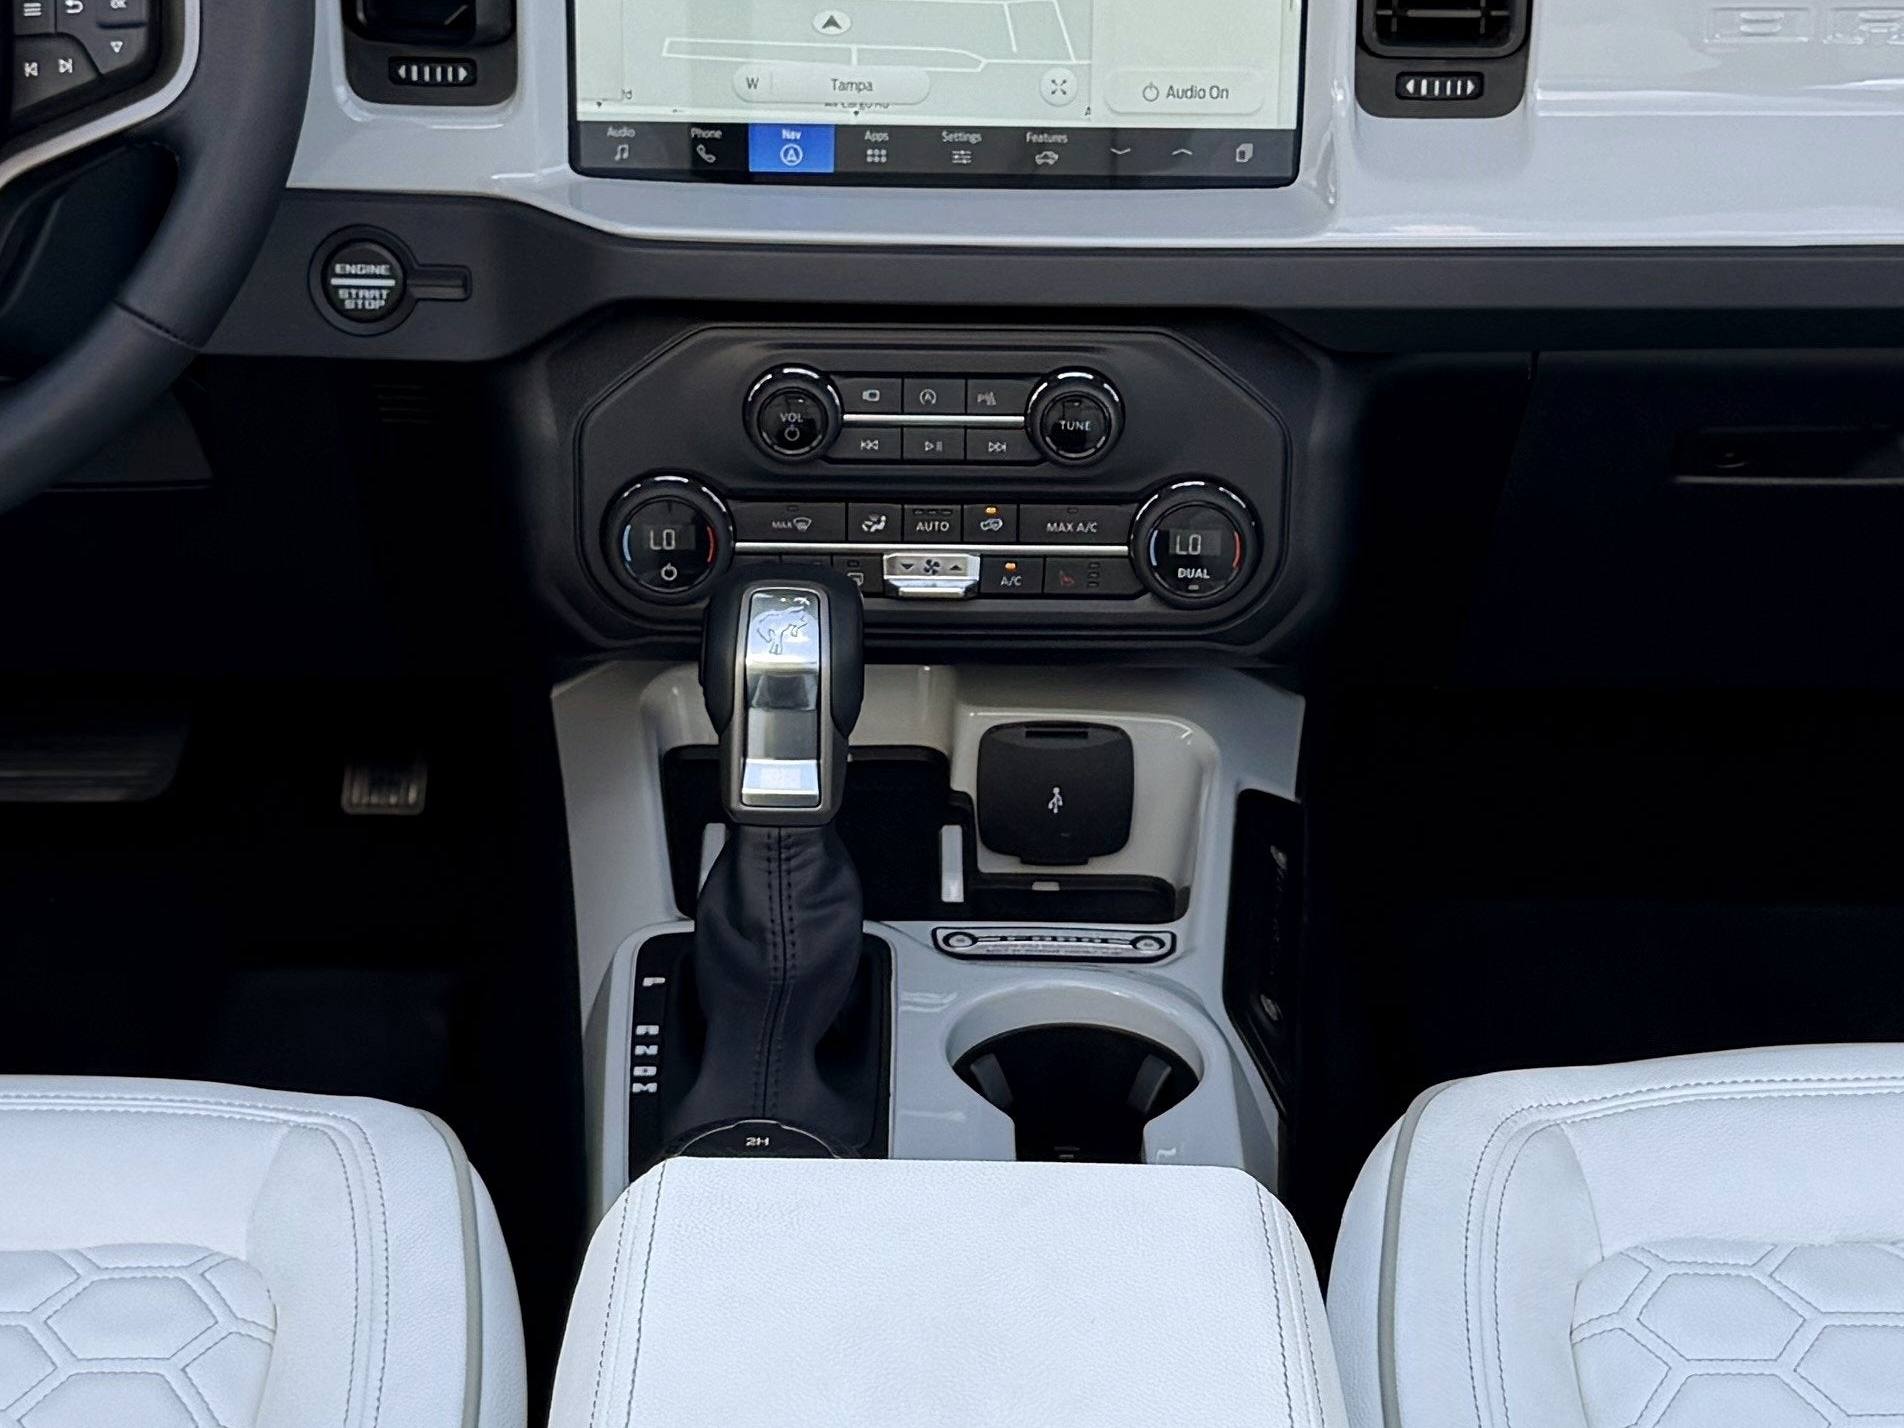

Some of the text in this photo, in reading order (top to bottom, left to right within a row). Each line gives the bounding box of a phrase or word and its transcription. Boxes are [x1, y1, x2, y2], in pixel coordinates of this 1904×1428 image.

[110, 0, 127, 9] OK
[746, 77, 874, 94] W Tampa
[1165, 84, 1230, 101] Audio On
[607, 126, 637, 139] Audio
[691, 127, 723, 140] Phone
[781, 128, 803, 141] Nav
[864, 130, 890, 143] Apps
[941, 130, 983, 145] Settings
[1025, 130, 1069, 145] Features
[334, 264, 391, 275] ENGINE
[337, 288, 390, 299] START
[343, 299, 386, 310] STOP
[780, 412, 804, 422] VOL
[1059, 420, 1093, 431] TUNE
[916, 521, 950, 532] AUTO
[1047, 521, 1098, 533] MAX A/C
[650, 529, 676, 550] LO
[1175, 534, 1201, 556] LO
[1177, 567, 1210, 579] DUAL
[1000, 575, 1022, 587] A/C
[634, 1044, 658, 1055] N
[632, 1082, 658, 1093] M
[745, 1137, 769, 1146] 2H
